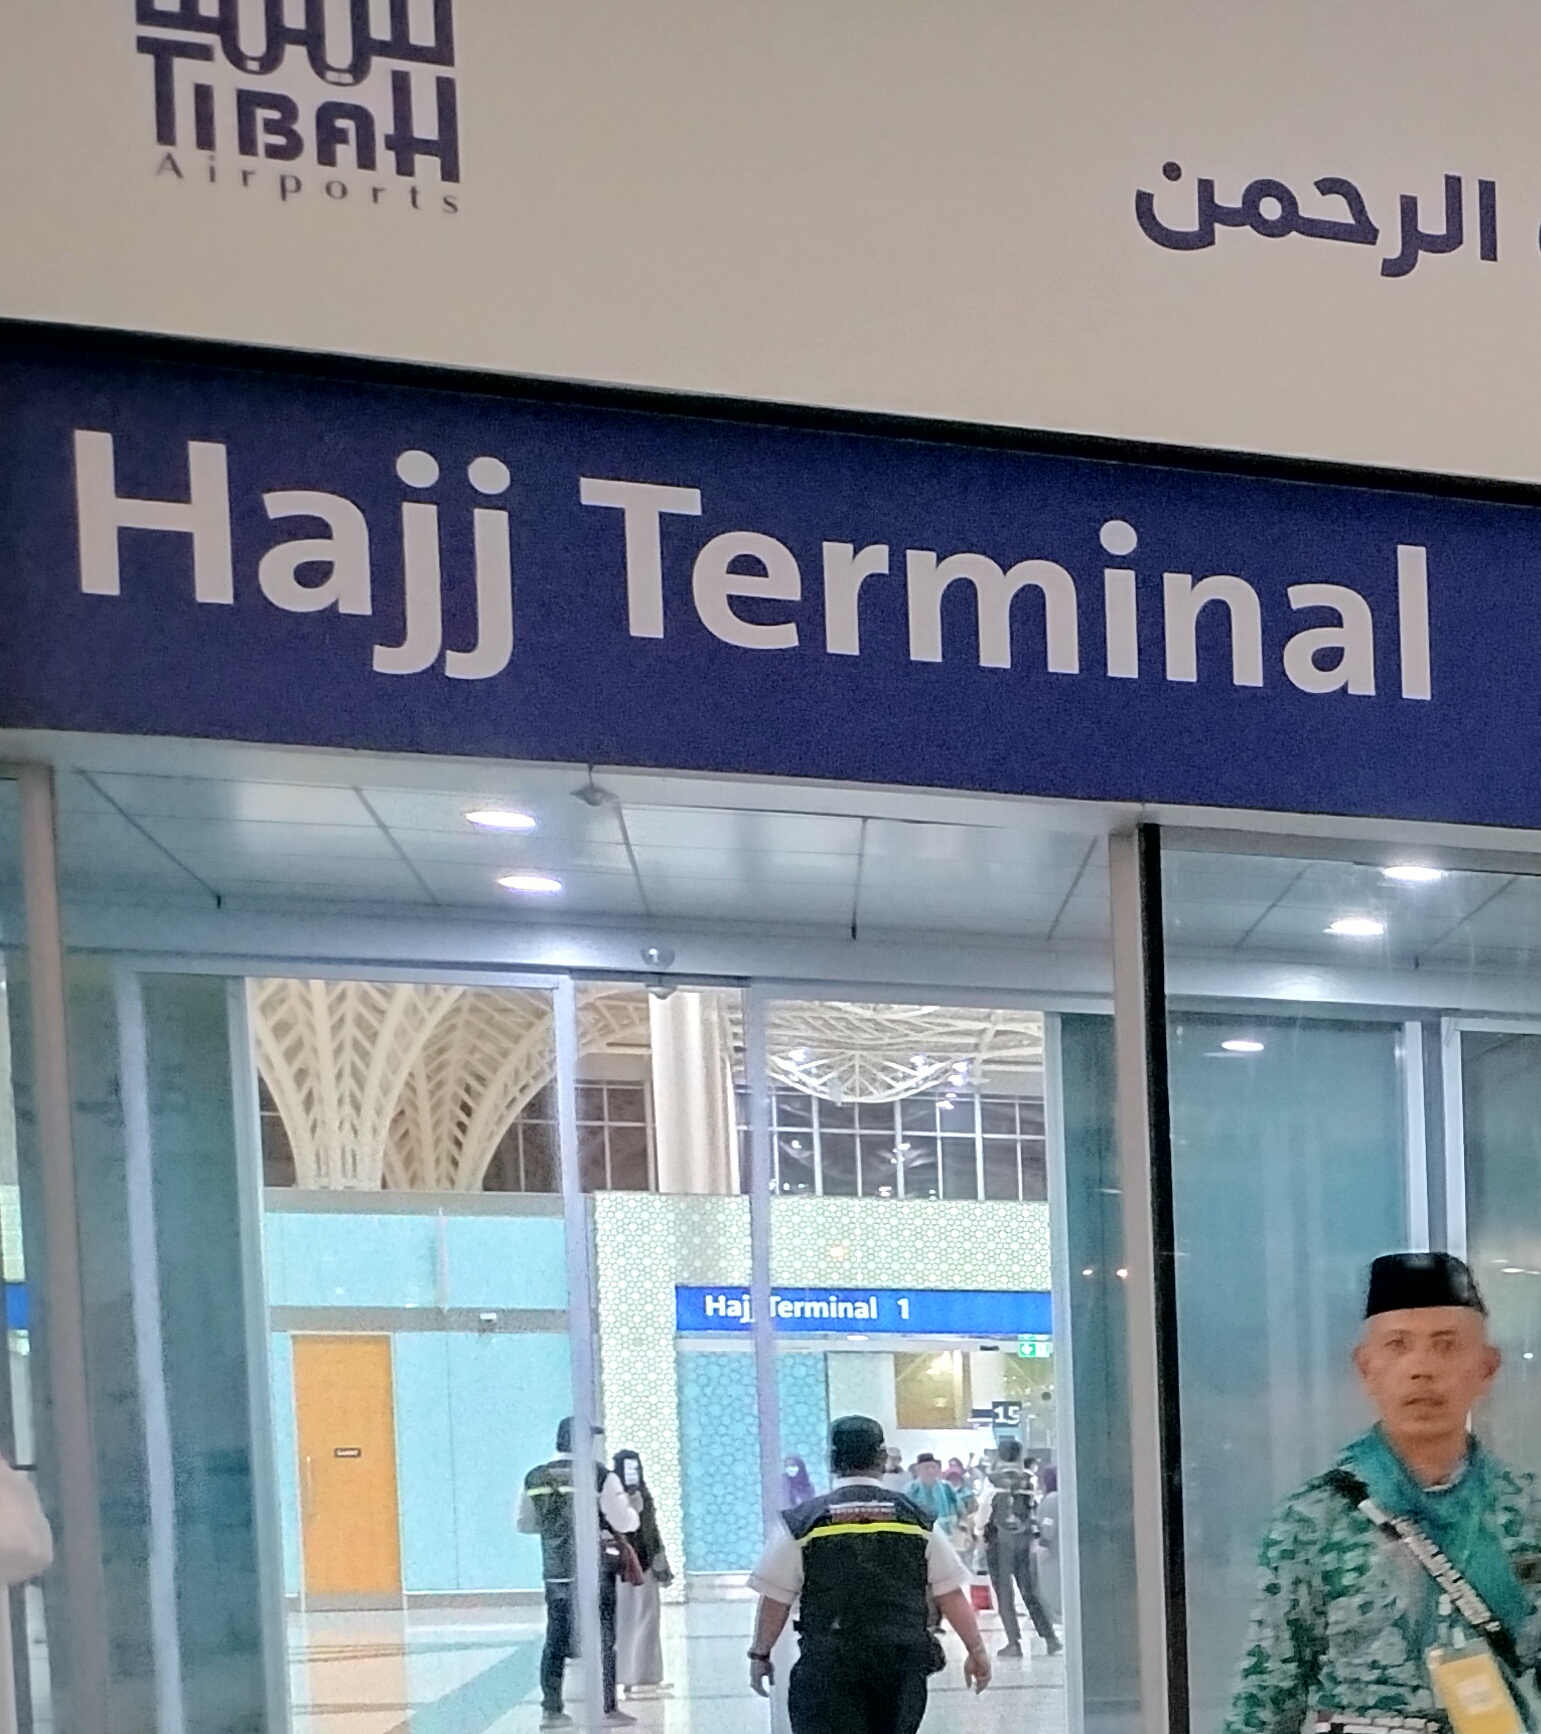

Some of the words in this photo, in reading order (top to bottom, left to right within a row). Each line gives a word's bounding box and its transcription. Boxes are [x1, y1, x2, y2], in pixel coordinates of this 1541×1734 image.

[136, 35, 461, 184] TIBAH
[155, 152, 461, 215] Airports
[1133, 160, 1499, 279] الرحمن
[73, 429, 515, 680] Hajj
[578, 476, 1432, 701] Terminal
[705, 1294, 755, 1323] Haj
[769, 1295, 877, 1319] Terminal
[897, 1298, 909, 1320] 1
[994, 1406, 1020, 1425] 15
